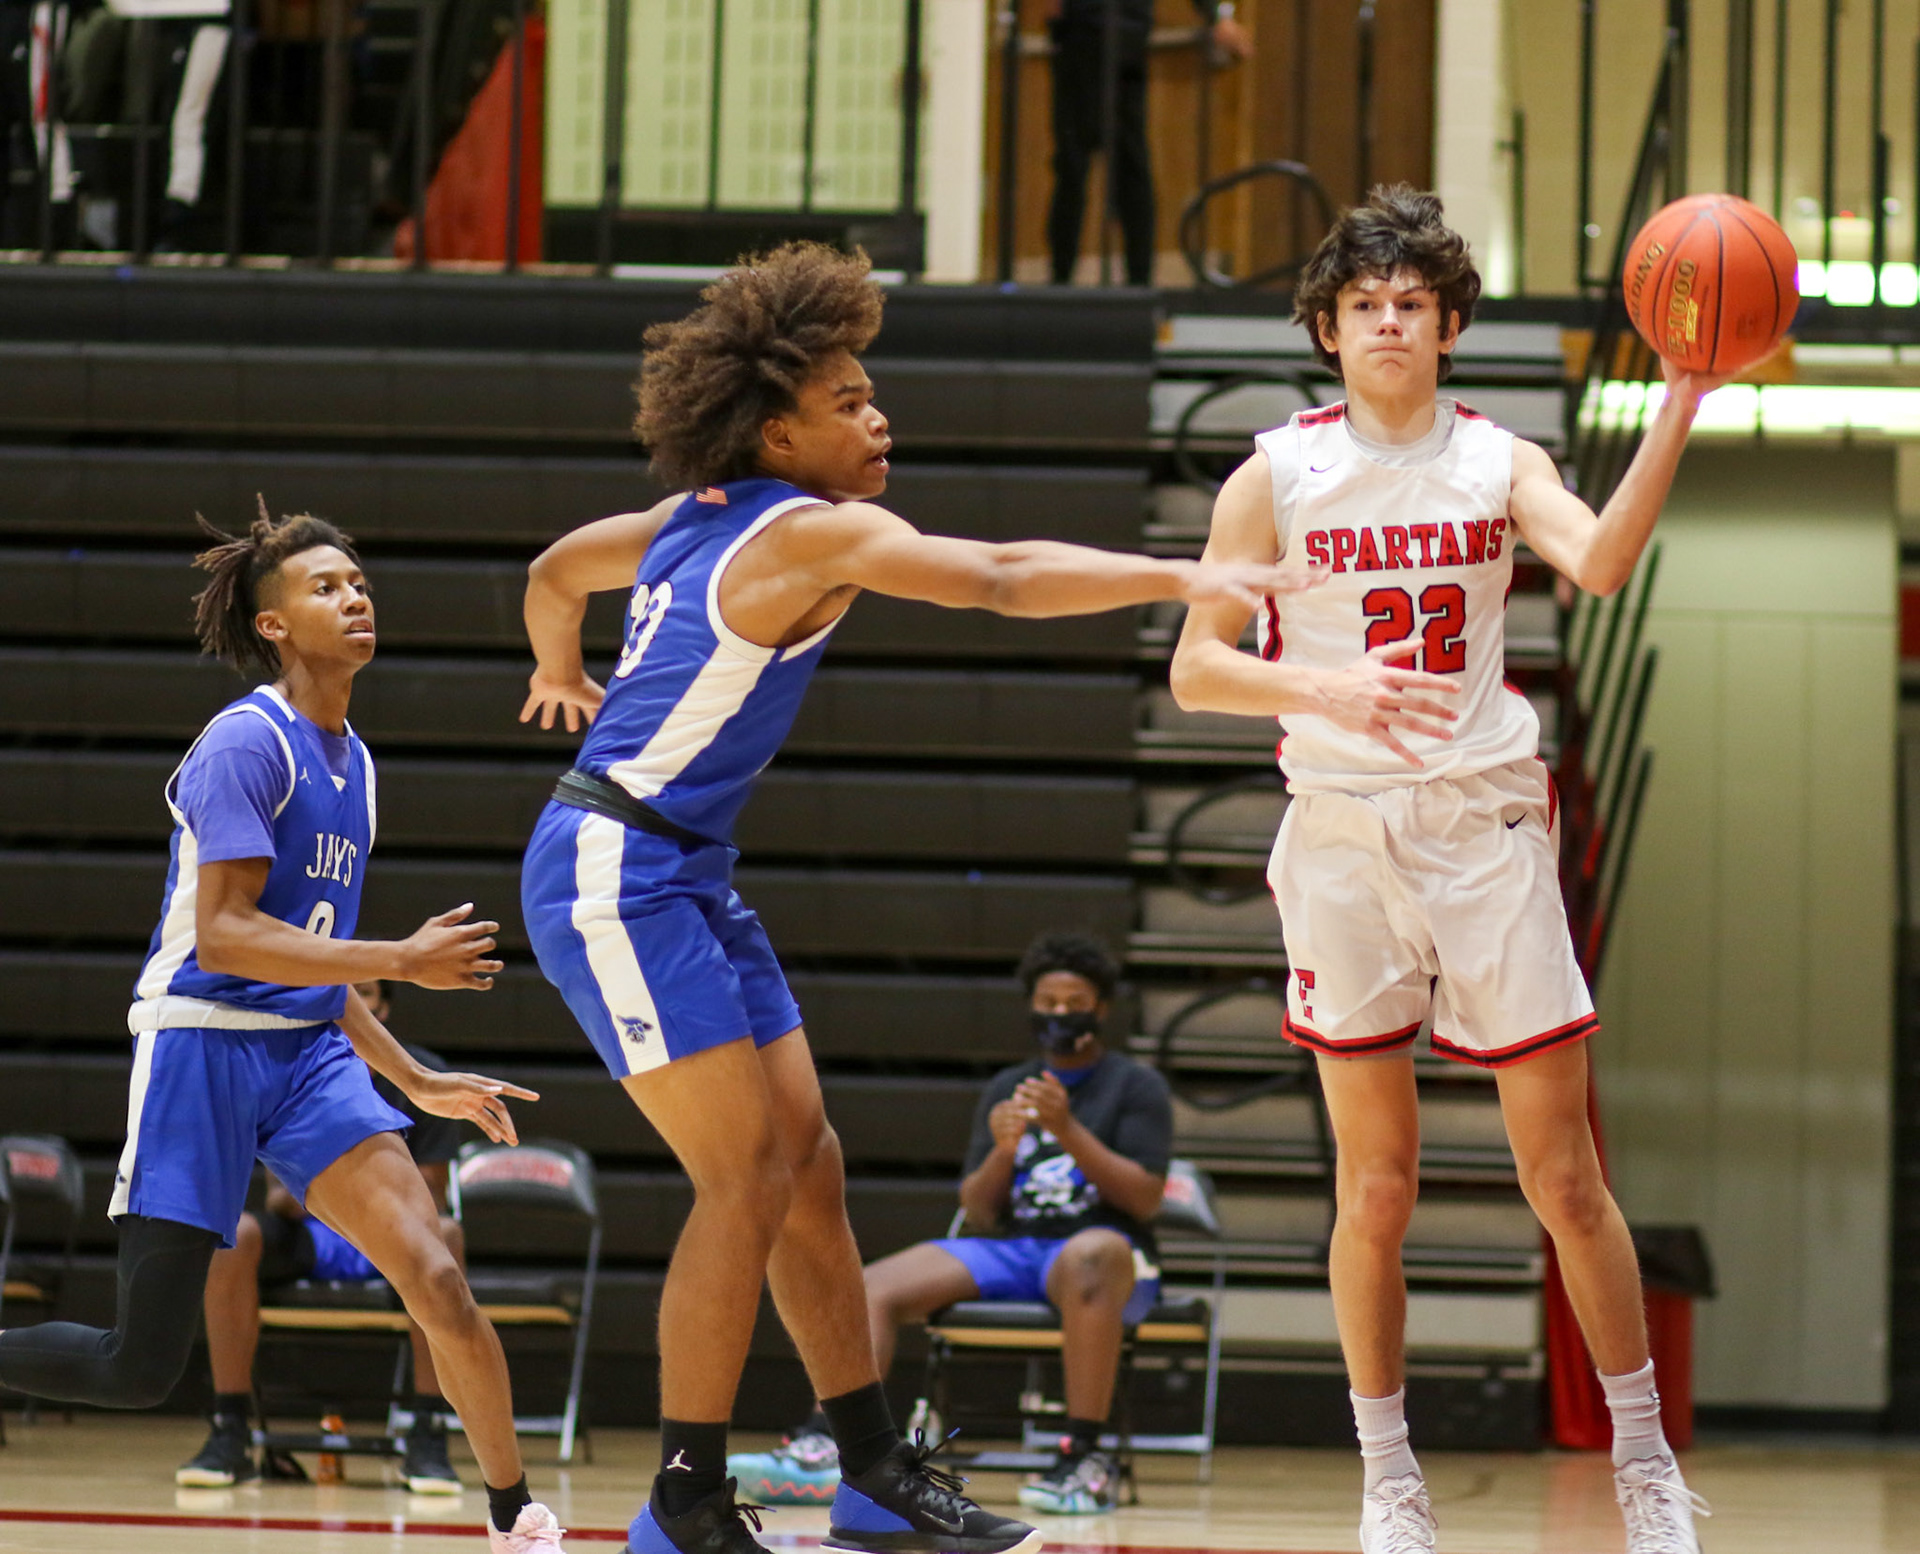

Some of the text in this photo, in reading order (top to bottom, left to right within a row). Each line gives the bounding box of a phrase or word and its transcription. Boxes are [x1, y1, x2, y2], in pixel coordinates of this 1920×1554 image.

[1305, 518, 1507, 573] SPARTANS
[1361, 583, 1466, 674] 22
[305, 832, 357, 888] JAYS
[1294, 968, 1315, 1023] E
